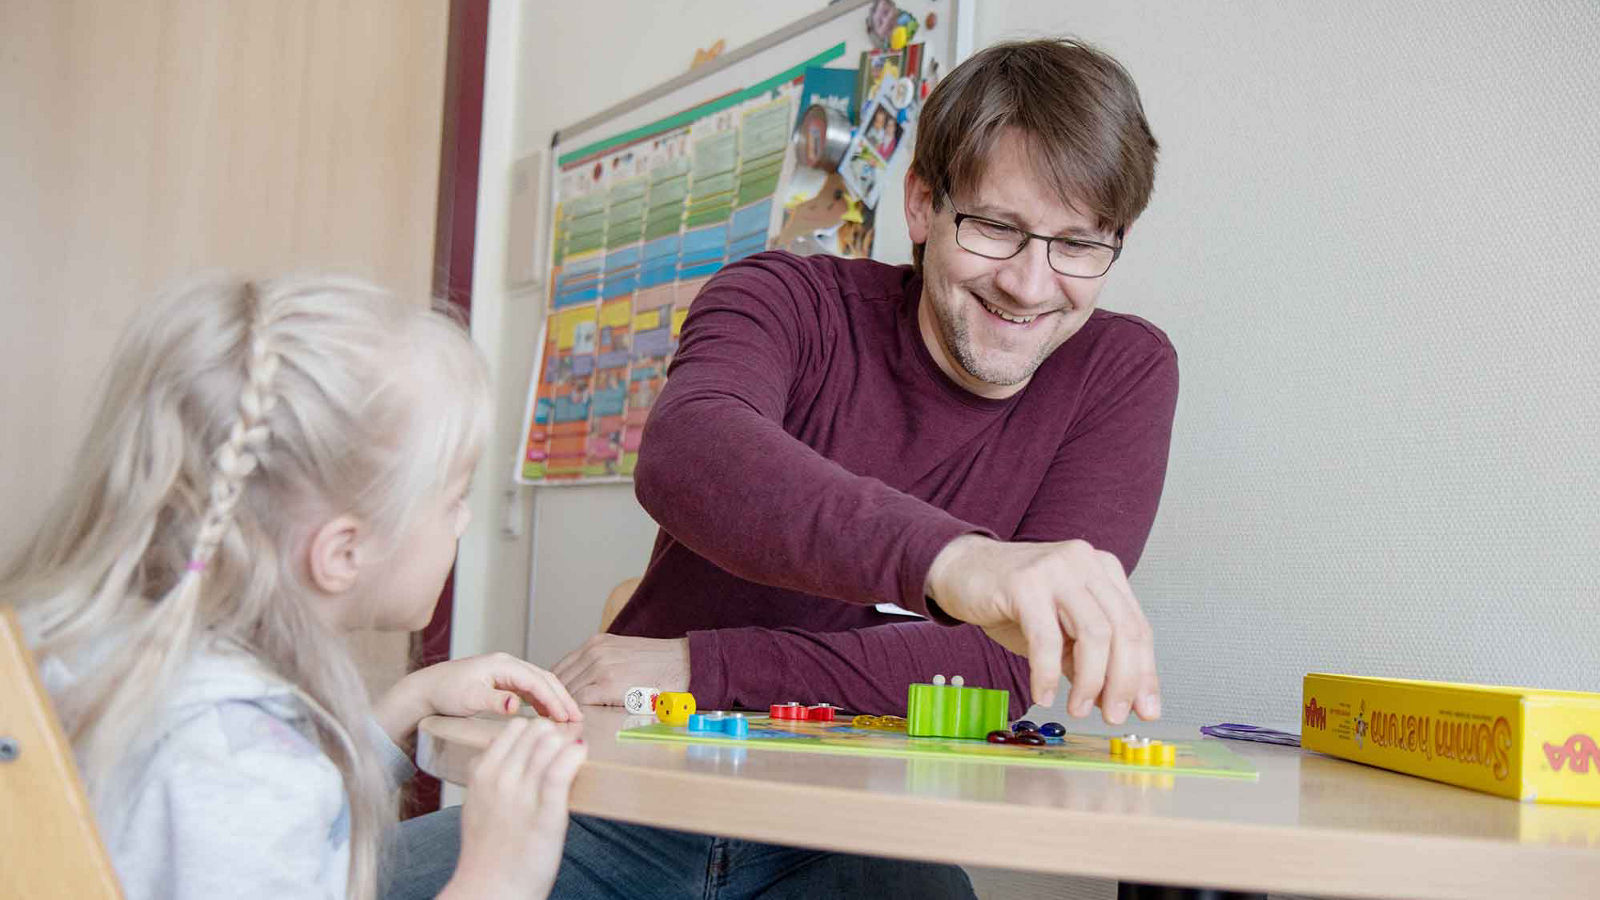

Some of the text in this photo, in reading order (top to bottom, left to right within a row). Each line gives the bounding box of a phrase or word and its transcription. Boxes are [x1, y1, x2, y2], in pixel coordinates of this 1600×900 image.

[1305, 697, 1327, 731] HABA
[1370, 709, 1512, 781] Summ herum
